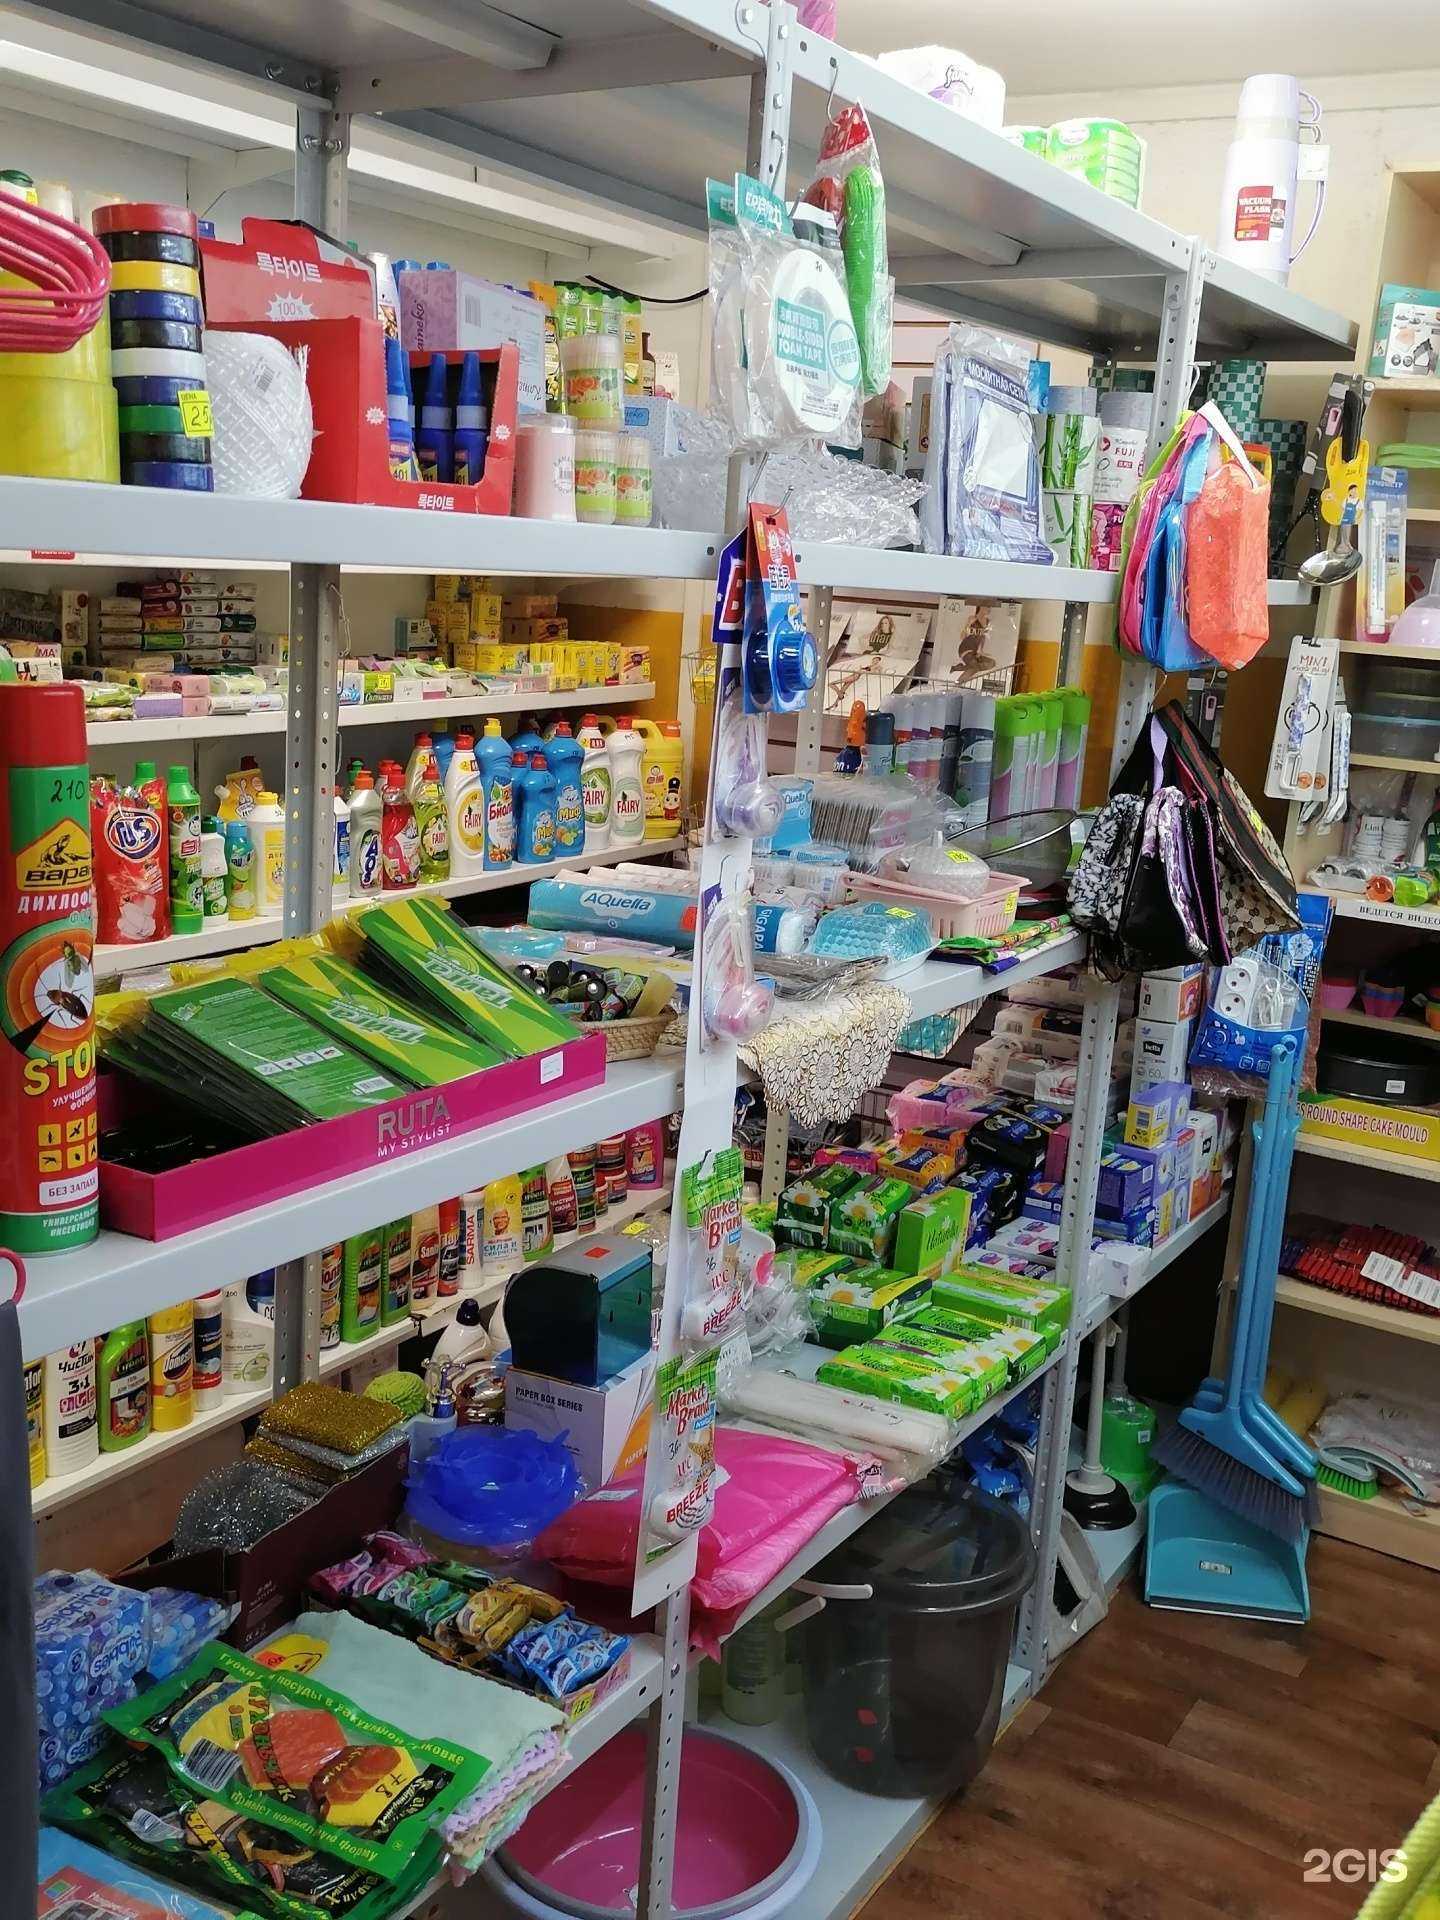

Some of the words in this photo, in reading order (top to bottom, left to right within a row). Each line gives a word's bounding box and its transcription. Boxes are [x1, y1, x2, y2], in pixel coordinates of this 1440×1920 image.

[256, 251, 322, 283] 록타이트
[1114, 447, 1136, 457] FUJI
[1300, 655, 1328, 668] MINI
[51, 780, 86, 802] 210
[464, 811, 482, 829] FAIRY
[617, 799, 640, 814] FAIRY
[583, 892, 651, 911] AQuella
[1359, 906, 1404, 920] ВЕДЕТСЯ
[377, 1094, 450, 1143] RUTA
[1307, 1104, 1338, 1124] ROUND
[1339, 1112, 1369, 1131] SHAPE
[1370, 1118, 1393, 1136] CAKE
[1394, 1122, 1428, 1143] MOULD
[377, 1142, 396, 1157] MY
[401, 1123, 451, 1149] STYLIST
[49, 1186, 68, 1197] БЕЗ
[466, 1215, 475, 1265] SARMA
[703, 1289, 742, 1336] BREEZE
[515, 1386, 539, 1400] PAPER
[540, 1393, 556, 1405] BOX
[557, 1399, 583, 1413] SERIES
[667, 1382, 706, 1421] Market
[677, 1397, 709, 1437] Brand
[665, 1478, 709, 1524] BREEZE
[276, 1674, 322, 1701] посуды
[337, 1838, 379, 1863] форму
